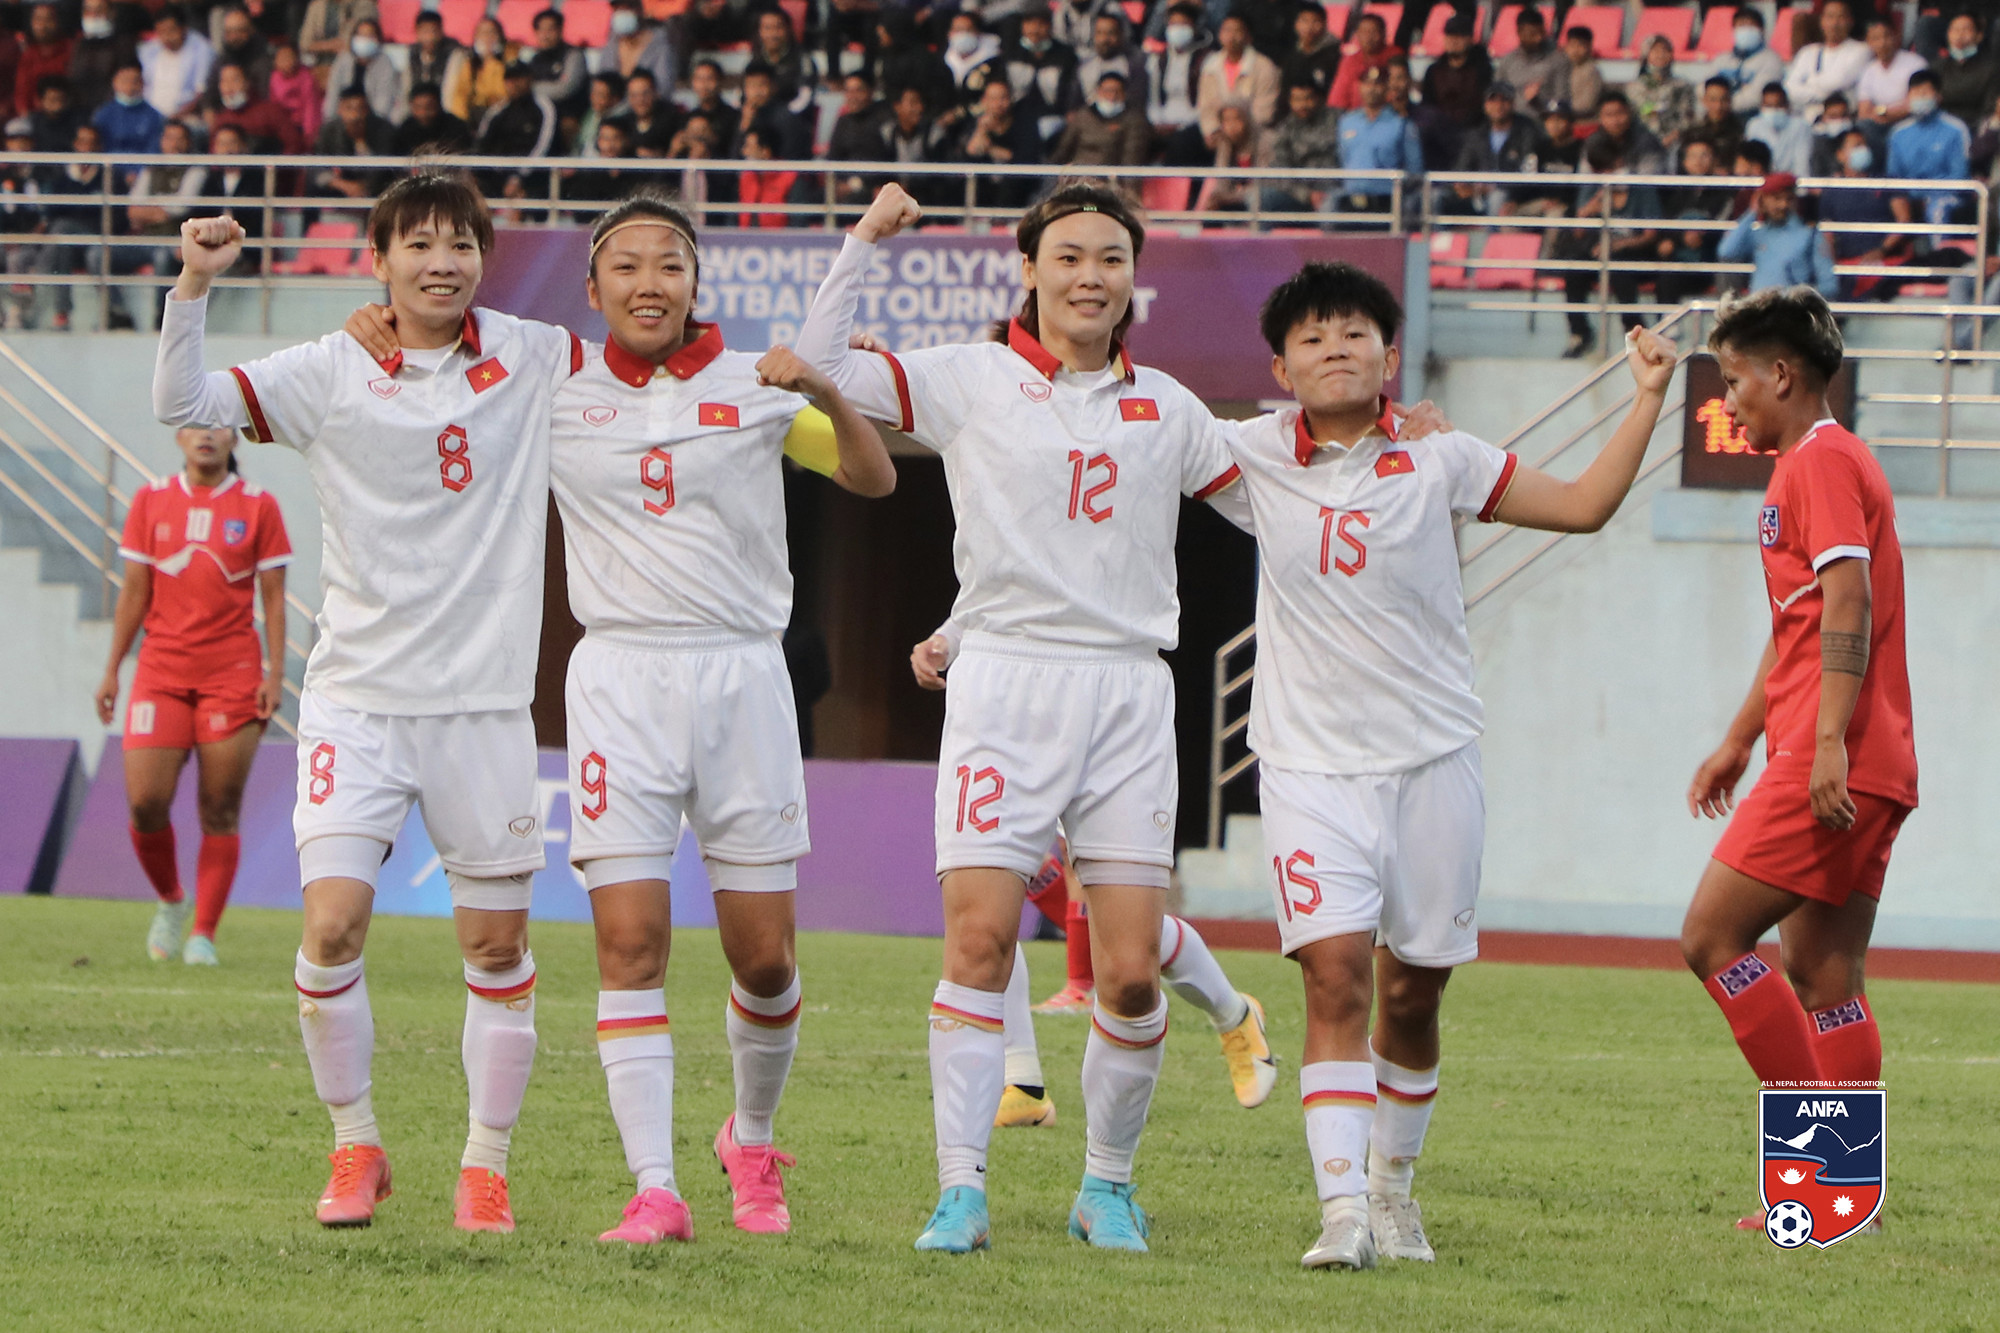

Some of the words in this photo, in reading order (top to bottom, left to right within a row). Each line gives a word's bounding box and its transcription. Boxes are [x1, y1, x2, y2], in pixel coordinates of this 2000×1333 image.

[697, 246, 893, 284] WOMES
[900, 247, 1021, 286] OLYM
[437, 424, 473, 493] 8
[640, 446, 675, 517] 9
[1068, 449, 1118, 523] 12
[186, 507, 213, 542] 10
[1319, 505, 1370, 577] 15
[130, 701, 156, 735] 10
[308, 742, 336, 806] 8
[581, 751, 607, 821] 9
[956, 764, 1005, 833] 12
[1274, 849, 1322, 922] 15
